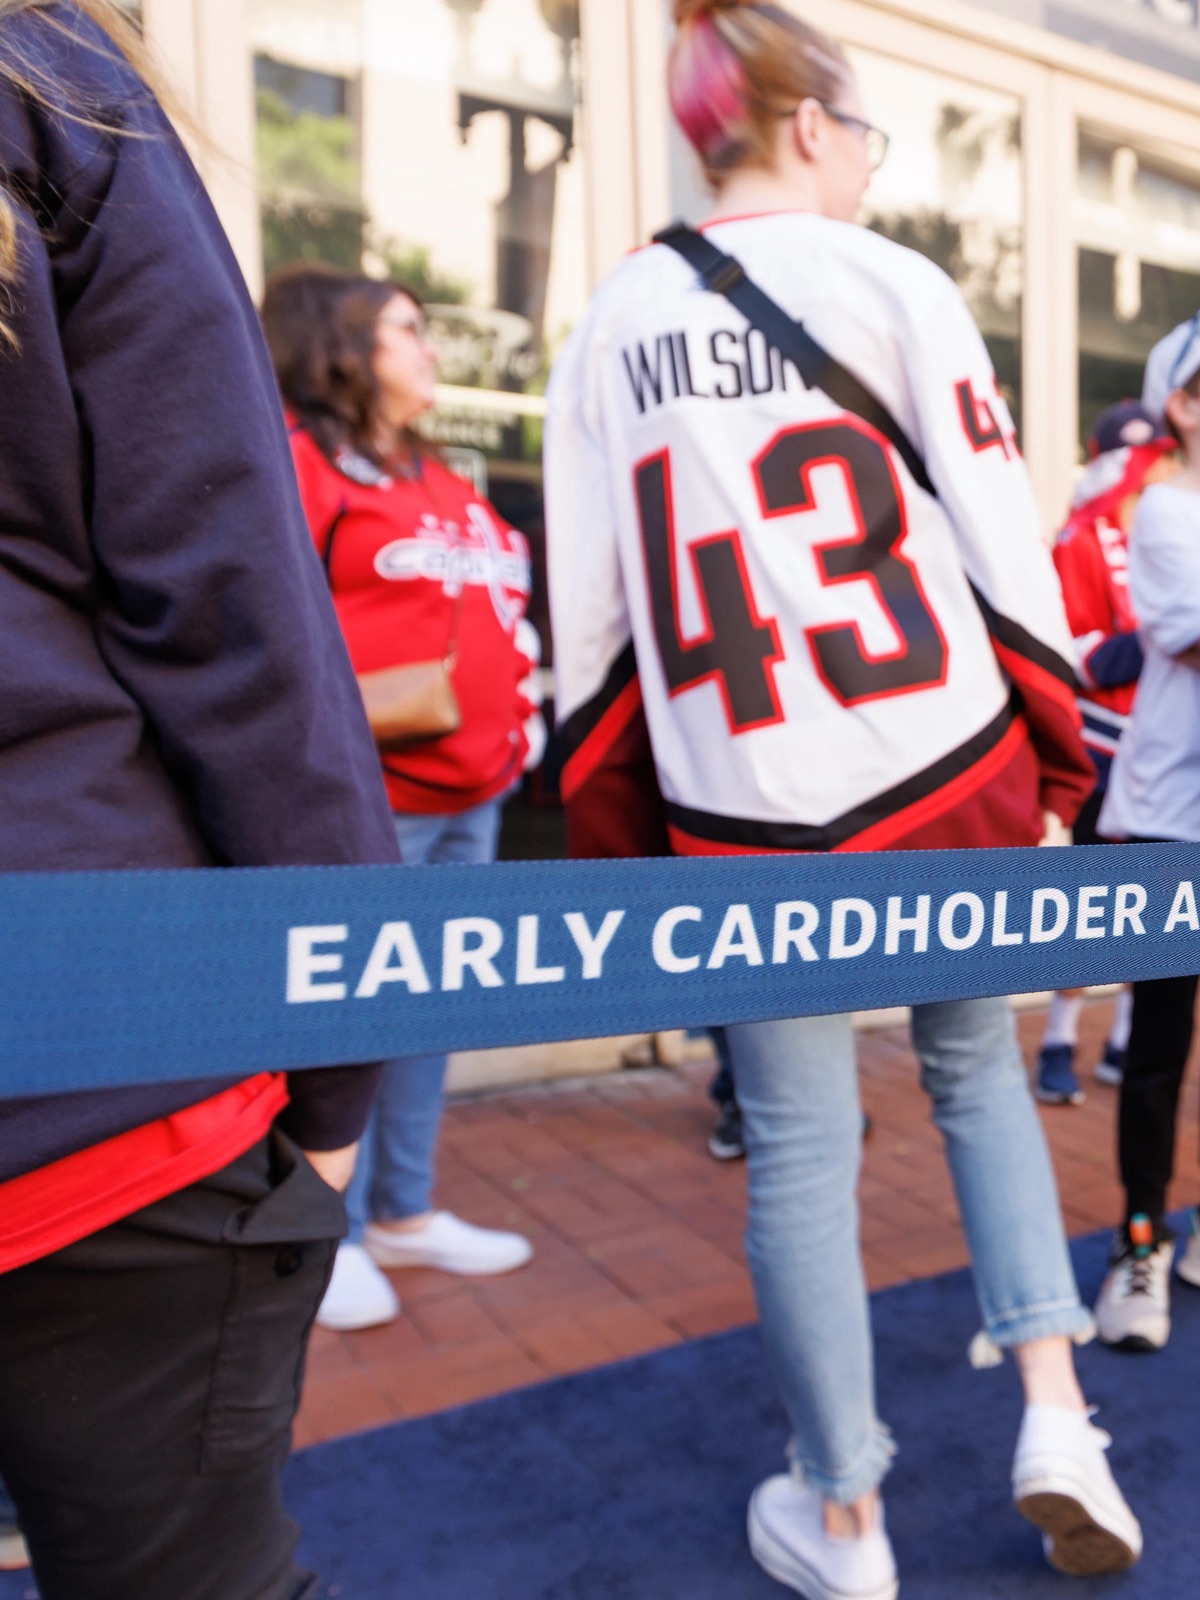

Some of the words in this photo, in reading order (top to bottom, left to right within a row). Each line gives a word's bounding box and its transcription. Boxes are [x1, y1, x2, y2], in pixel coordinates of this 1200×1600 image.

[954, 371, 1023, 461] 4
[633, 410, 949, 736] 43
[285, 910, 626, 1004] EARLY
[651, 883, 1147, 974] CARDHOLDER
